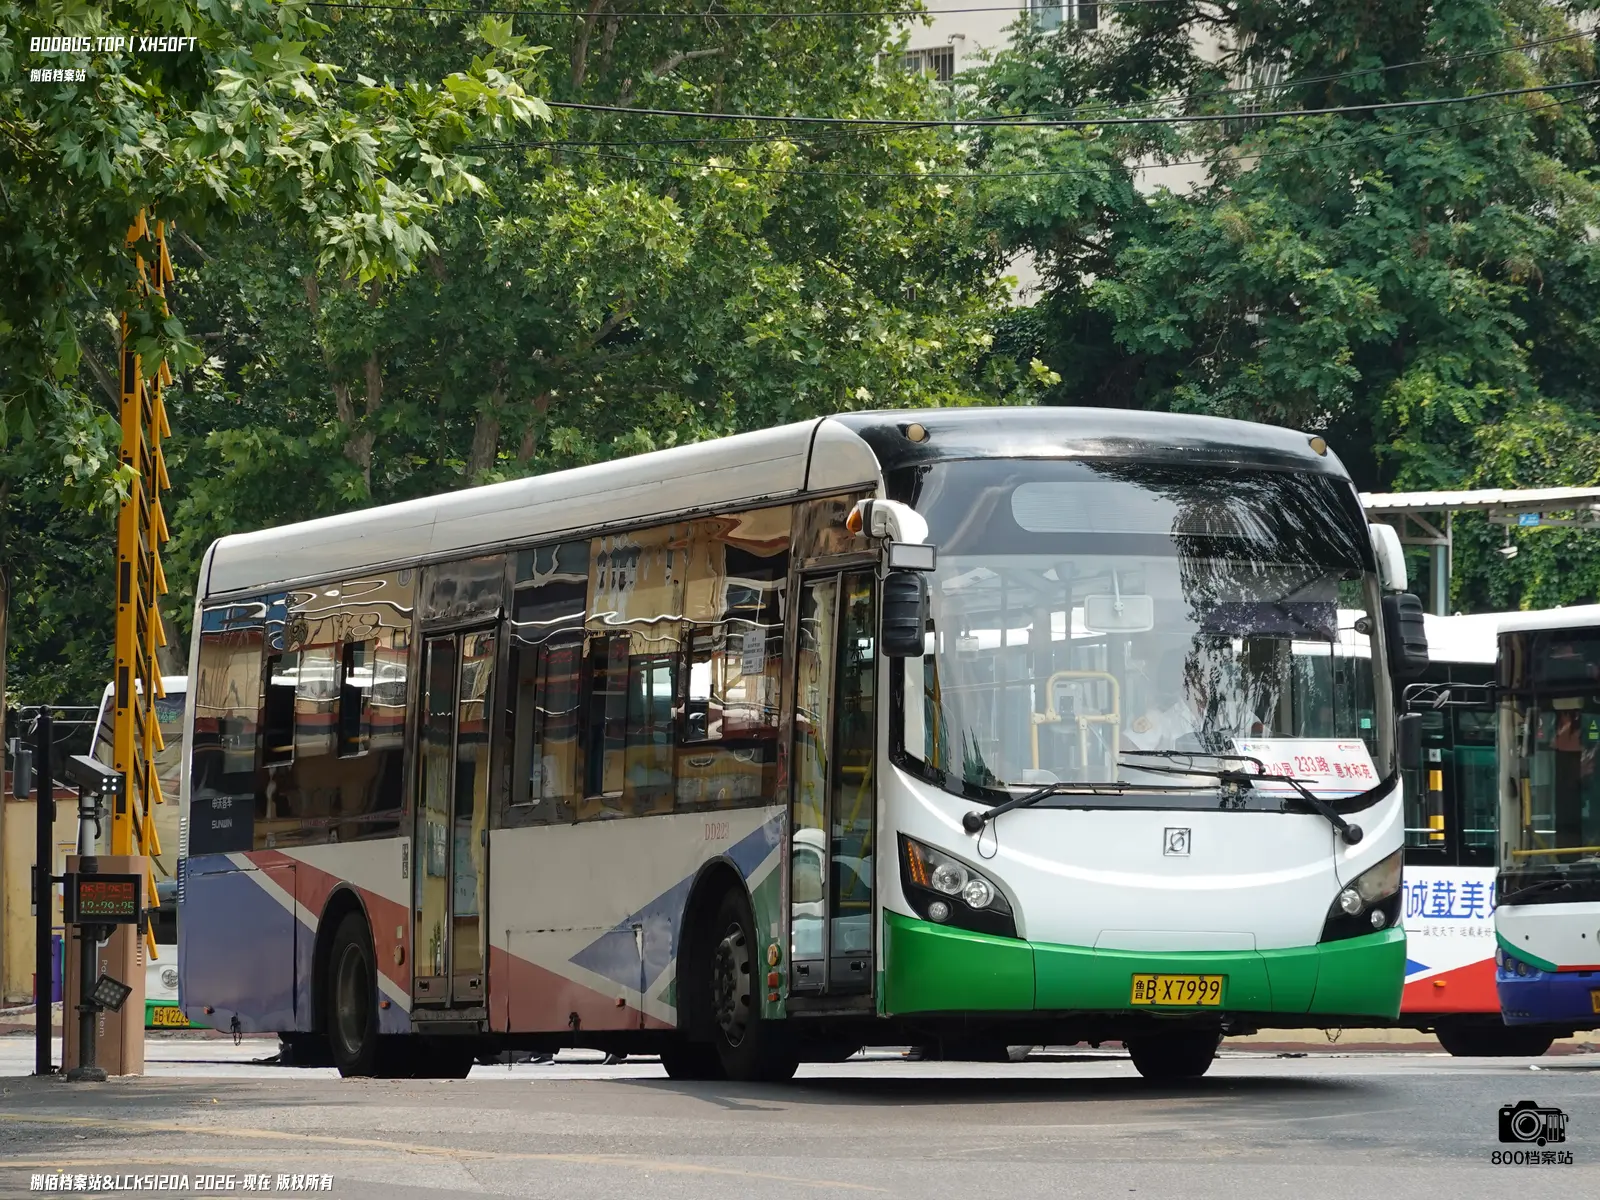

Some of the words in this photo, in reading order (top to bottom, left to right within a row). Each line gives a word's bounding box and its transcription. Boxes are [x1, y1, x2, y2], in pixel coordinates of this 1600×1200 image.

[1294, 755, 1331, 773] 233路
[1333, 763, 1373, 779] 惠水和苑
[211, 818, 233, 830] SUNWIN
